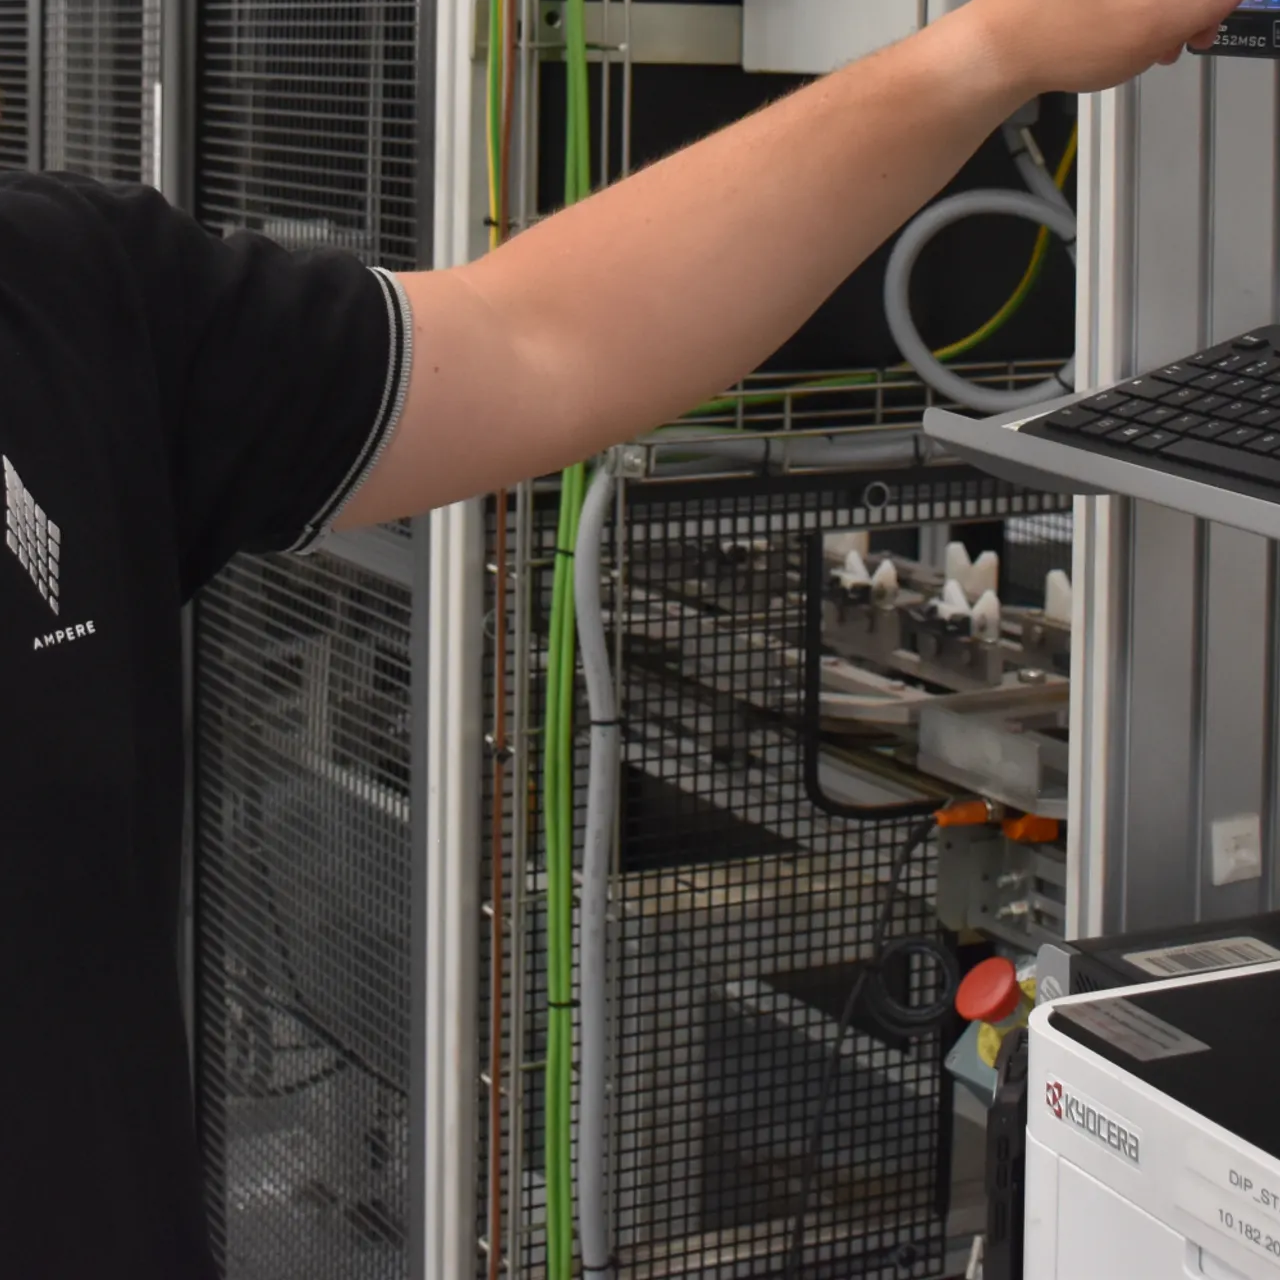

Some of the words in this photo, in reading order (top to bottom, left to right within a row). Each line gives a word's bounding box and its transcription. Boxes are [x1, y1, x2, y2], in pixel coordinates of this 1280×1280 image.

[1213, 33, 1266, 48] 252MSC
[33, 620, 96, 650] AMPERE
[1064, 1093, 1139, 1163] KYOCERA
